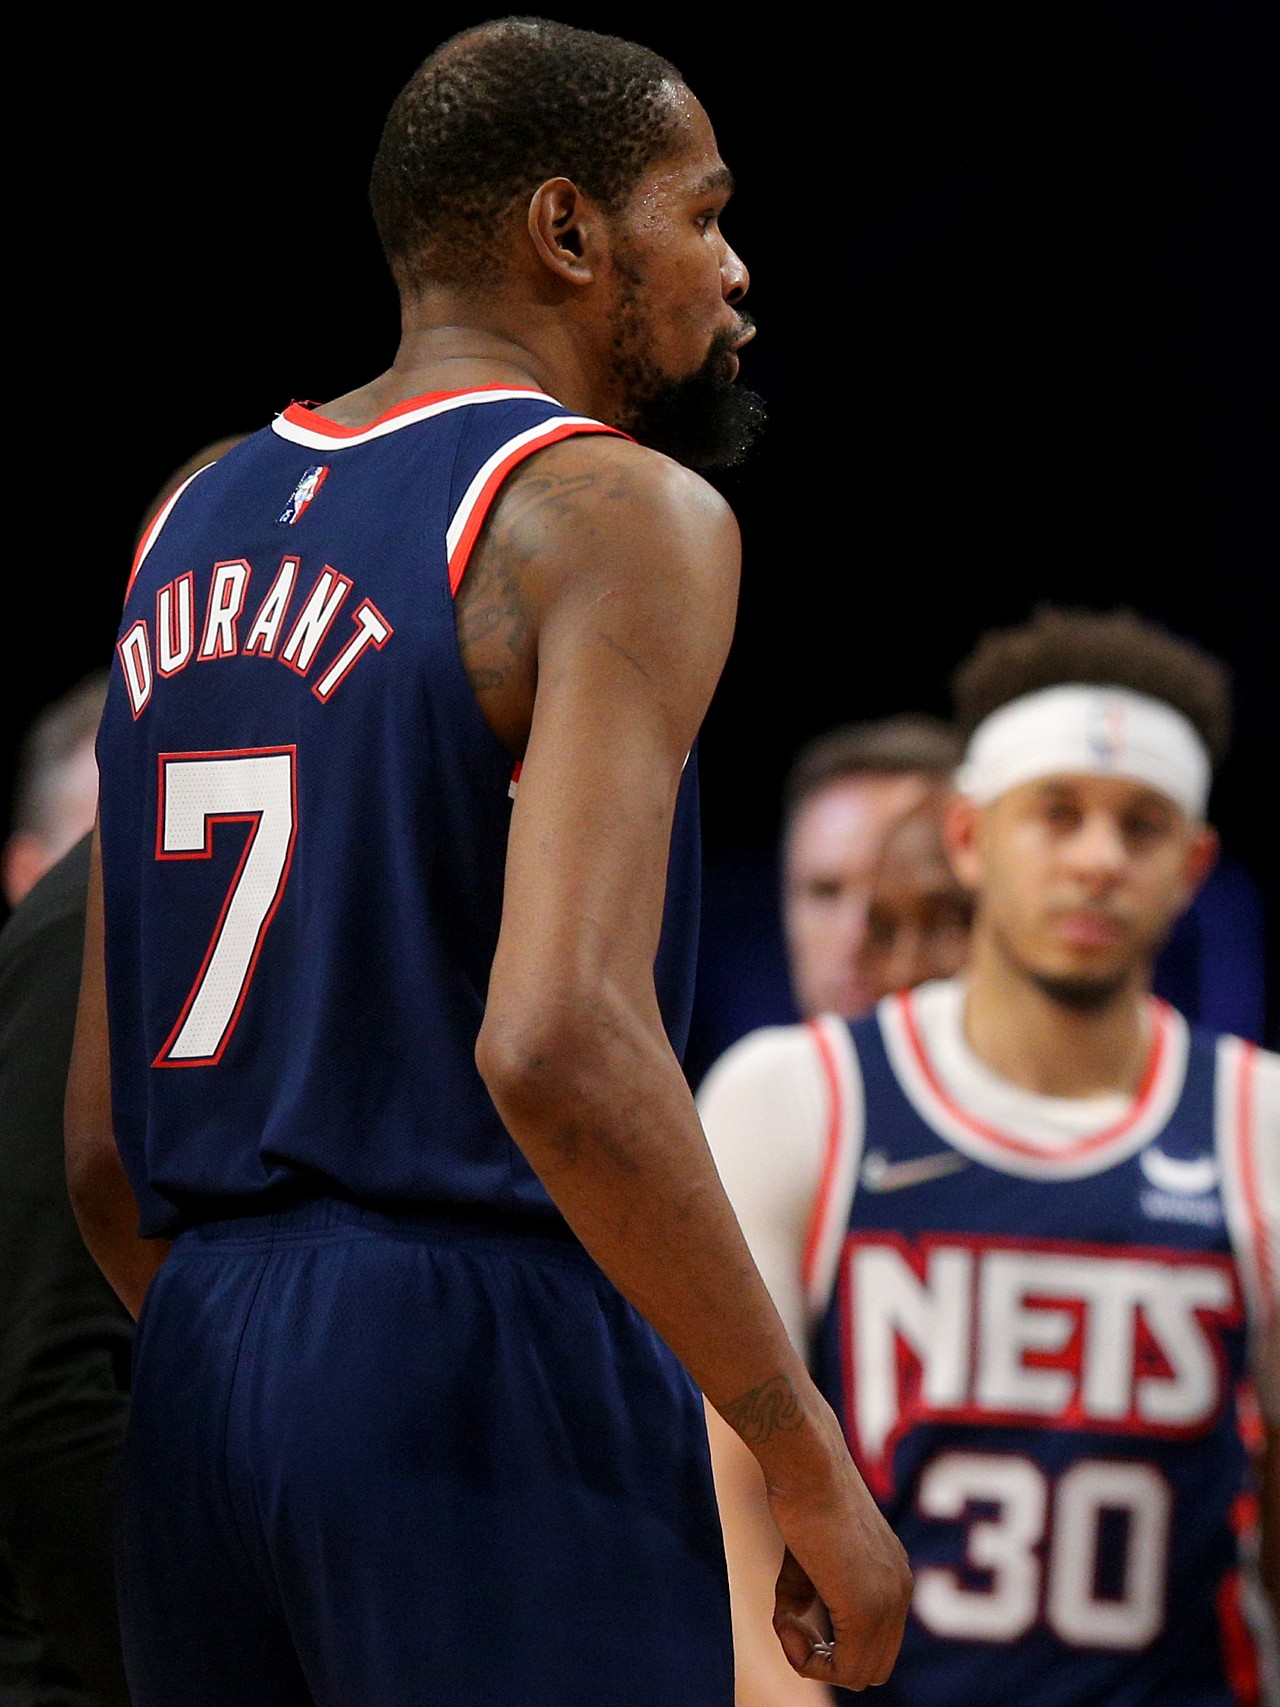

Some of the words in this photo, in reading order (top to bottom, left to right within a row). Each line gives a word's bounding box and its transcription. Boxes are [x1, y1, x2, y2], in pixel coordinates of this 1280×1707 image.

[117, 556, 393, 721] DURANT
[152, 744, 297, 1068] 7
[844, 1236, 1246, 1480] NETS
[911, 1449, 1172, 1650] 30
